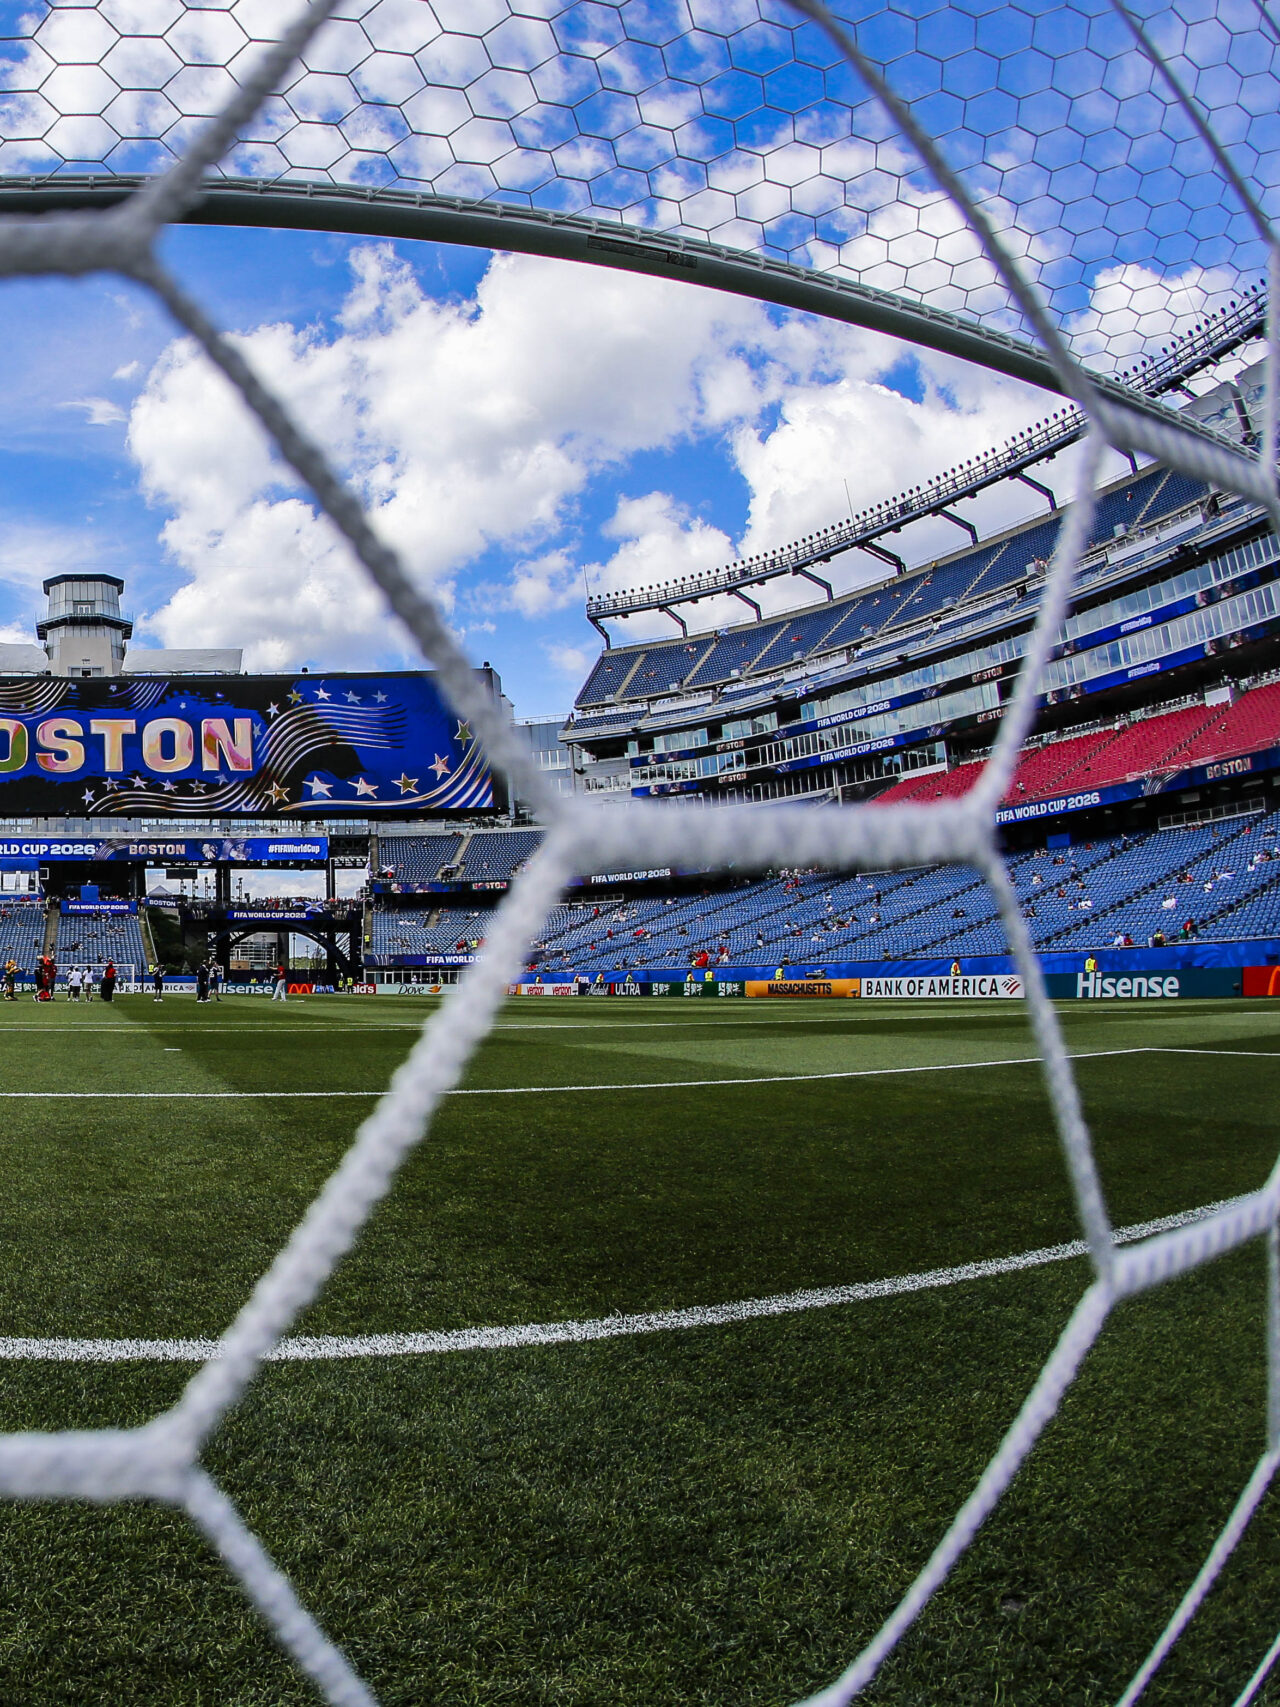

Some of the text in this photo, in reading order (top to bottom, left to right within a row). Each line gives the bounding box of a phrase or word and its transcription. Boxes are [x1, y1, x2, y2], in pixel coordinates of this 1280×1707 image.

[817, 700, 891, 728] FIFA WORLD CUP 2026
[820, 737, 895, 763] FIFA WORLD CUP 2026
[1206, 757, 1252, 779] BOSTON
[995, 791, 1100, 824] FIFA WORLD CUP 2026
[21, 844, 48, 855] CUP
[49, 843, 96, 855] 2026
[129, 844, 186, 855] BOSTON
[268, 844, 320, 855] #FIFAWorldCup
[591, 868, 671, 884] FIFA WORLD CUP 2026
[149, 899, 176, 907] BOSTON
[233, 911, 307, 919] FIFA WORLD CUP 2026
[426, 955, 444, 964] FIFA
[444, 955, 474, 963] WORLD
[398, 982, 424, 995] Dove
[615, 982, 641, 996] ULTRA
[767, 982, 832, 996] MASSACHUSETTS
[866, 978, 999, 996] BANK OF AMERICA
[1076, 972, 1180, 998] Hisense
